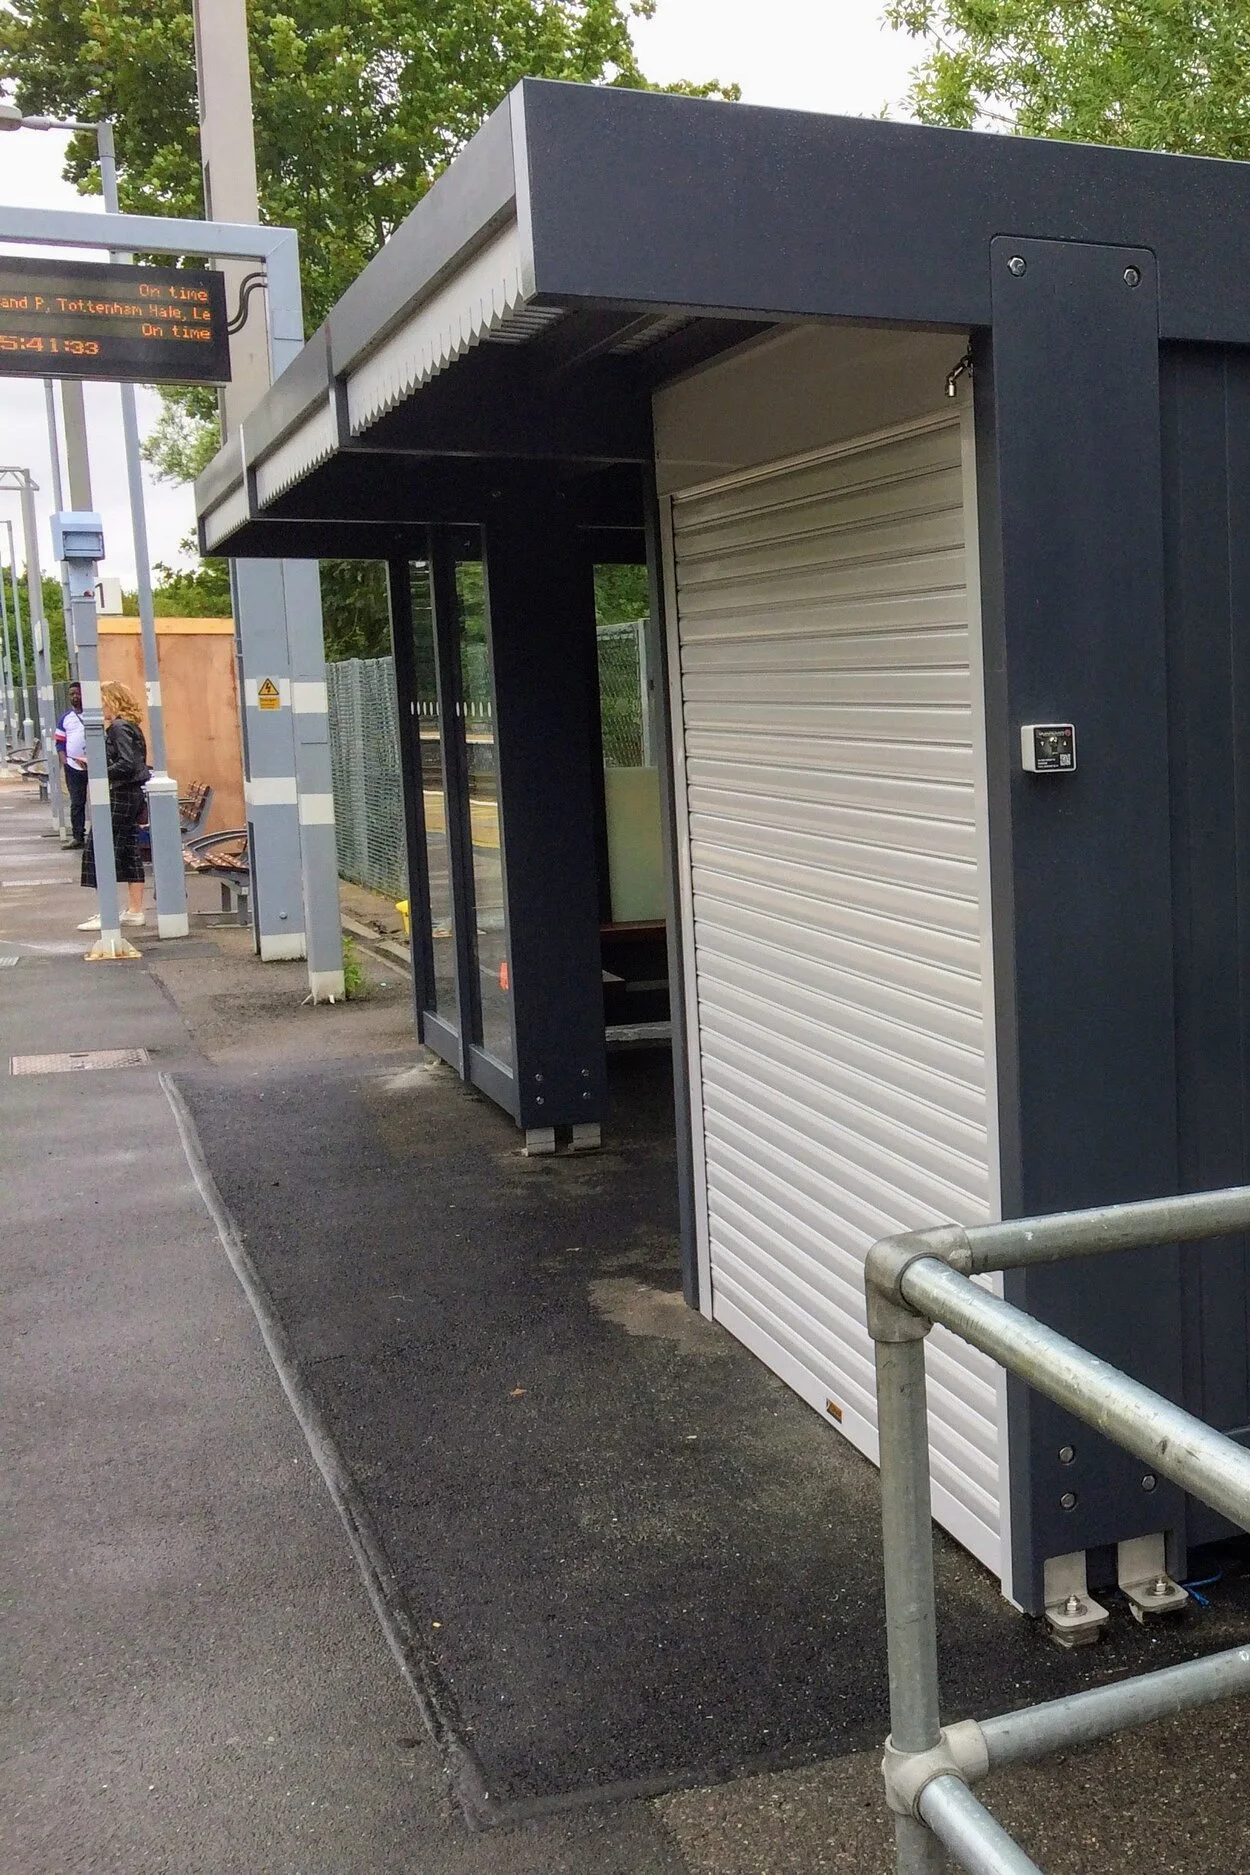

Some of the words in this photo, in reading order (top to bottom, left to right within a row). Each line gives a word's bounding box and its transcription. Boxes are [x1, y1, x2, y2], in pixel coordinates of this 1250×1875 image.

[139, 284, 160, 297] On
[169, 286, 209, 301] time
[35, 296, 50, 314] P,
[56, 298, 142, 317] Tottenham
[149, 305, 187, 322] Hale,
[193, 307, 211, 321] Le
[141, 323, 163, 336] On
[172, 325, 212, 339] time
